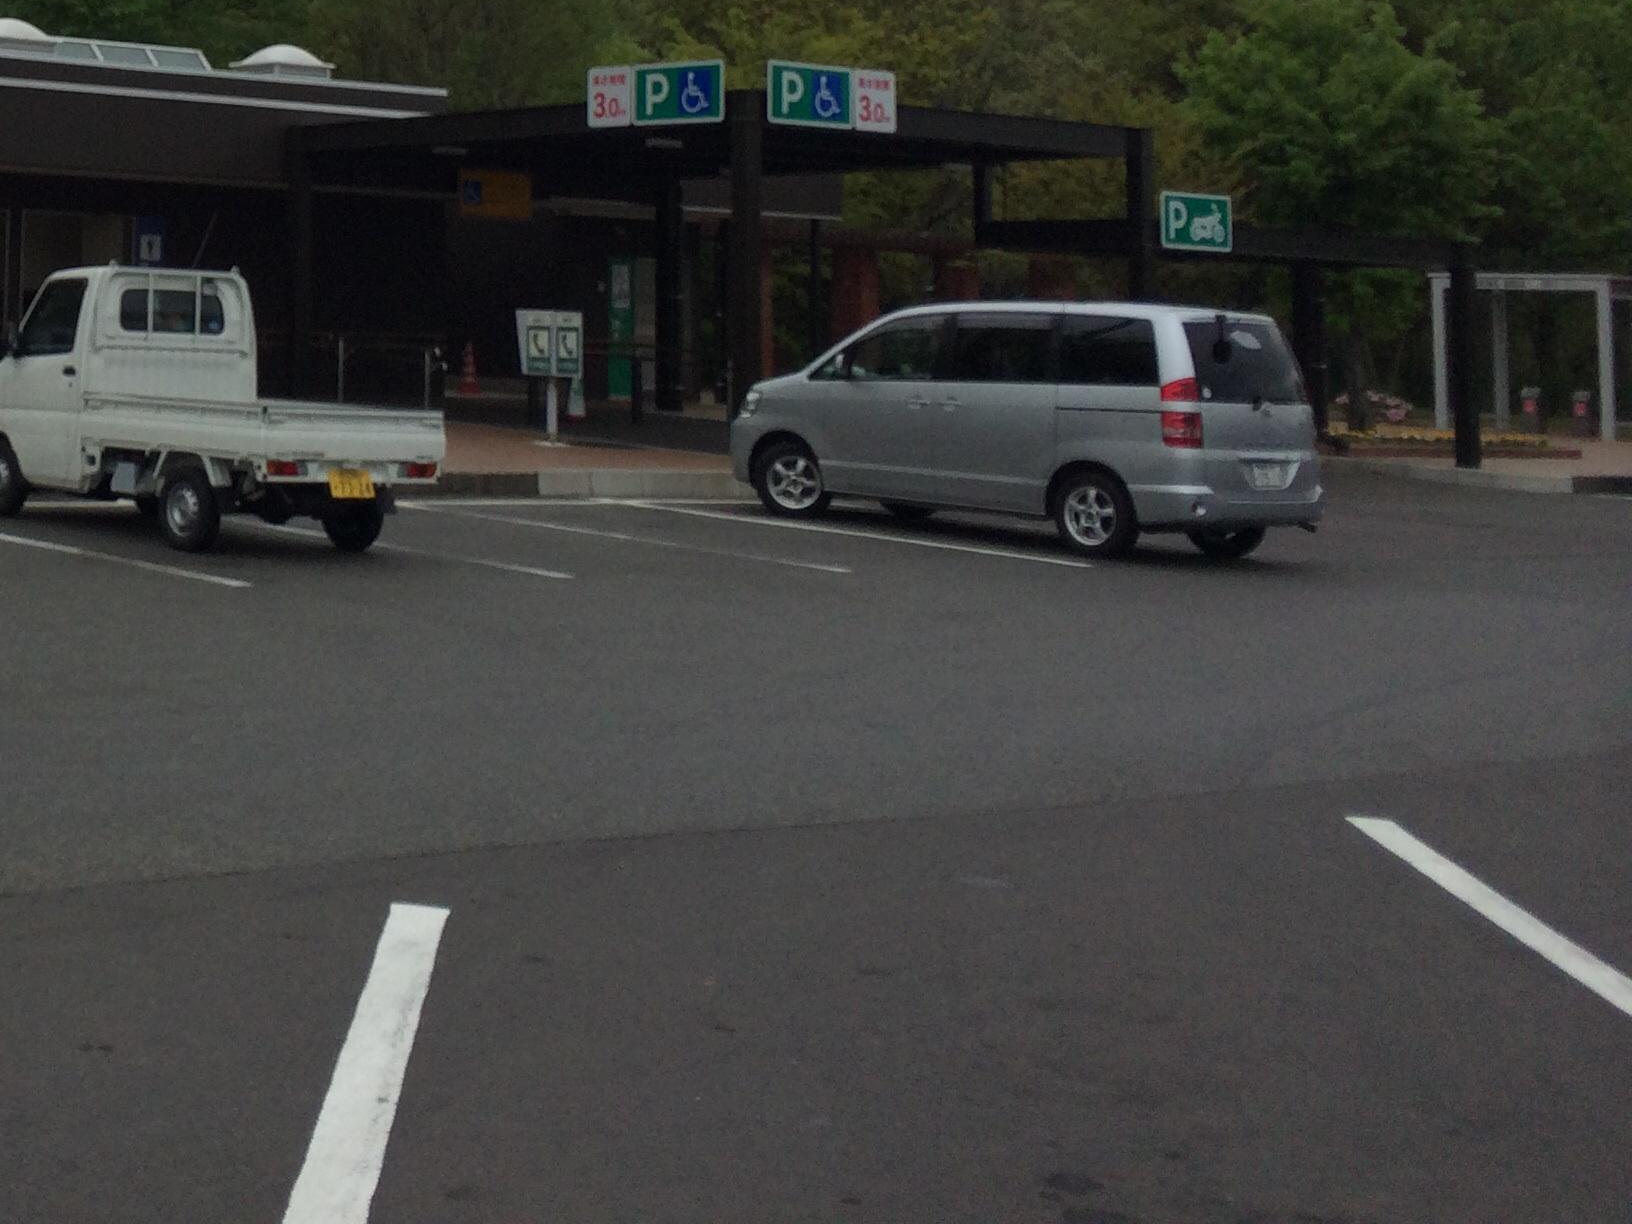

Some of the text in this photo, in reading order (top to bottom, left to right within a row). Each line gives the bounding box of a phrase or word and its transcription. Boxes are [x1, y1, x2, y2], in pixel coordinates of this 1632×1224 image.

[645, 73, 669, 116] P
[782, 71, 804, 114] P
[1169, 201, 1187, 239] P
